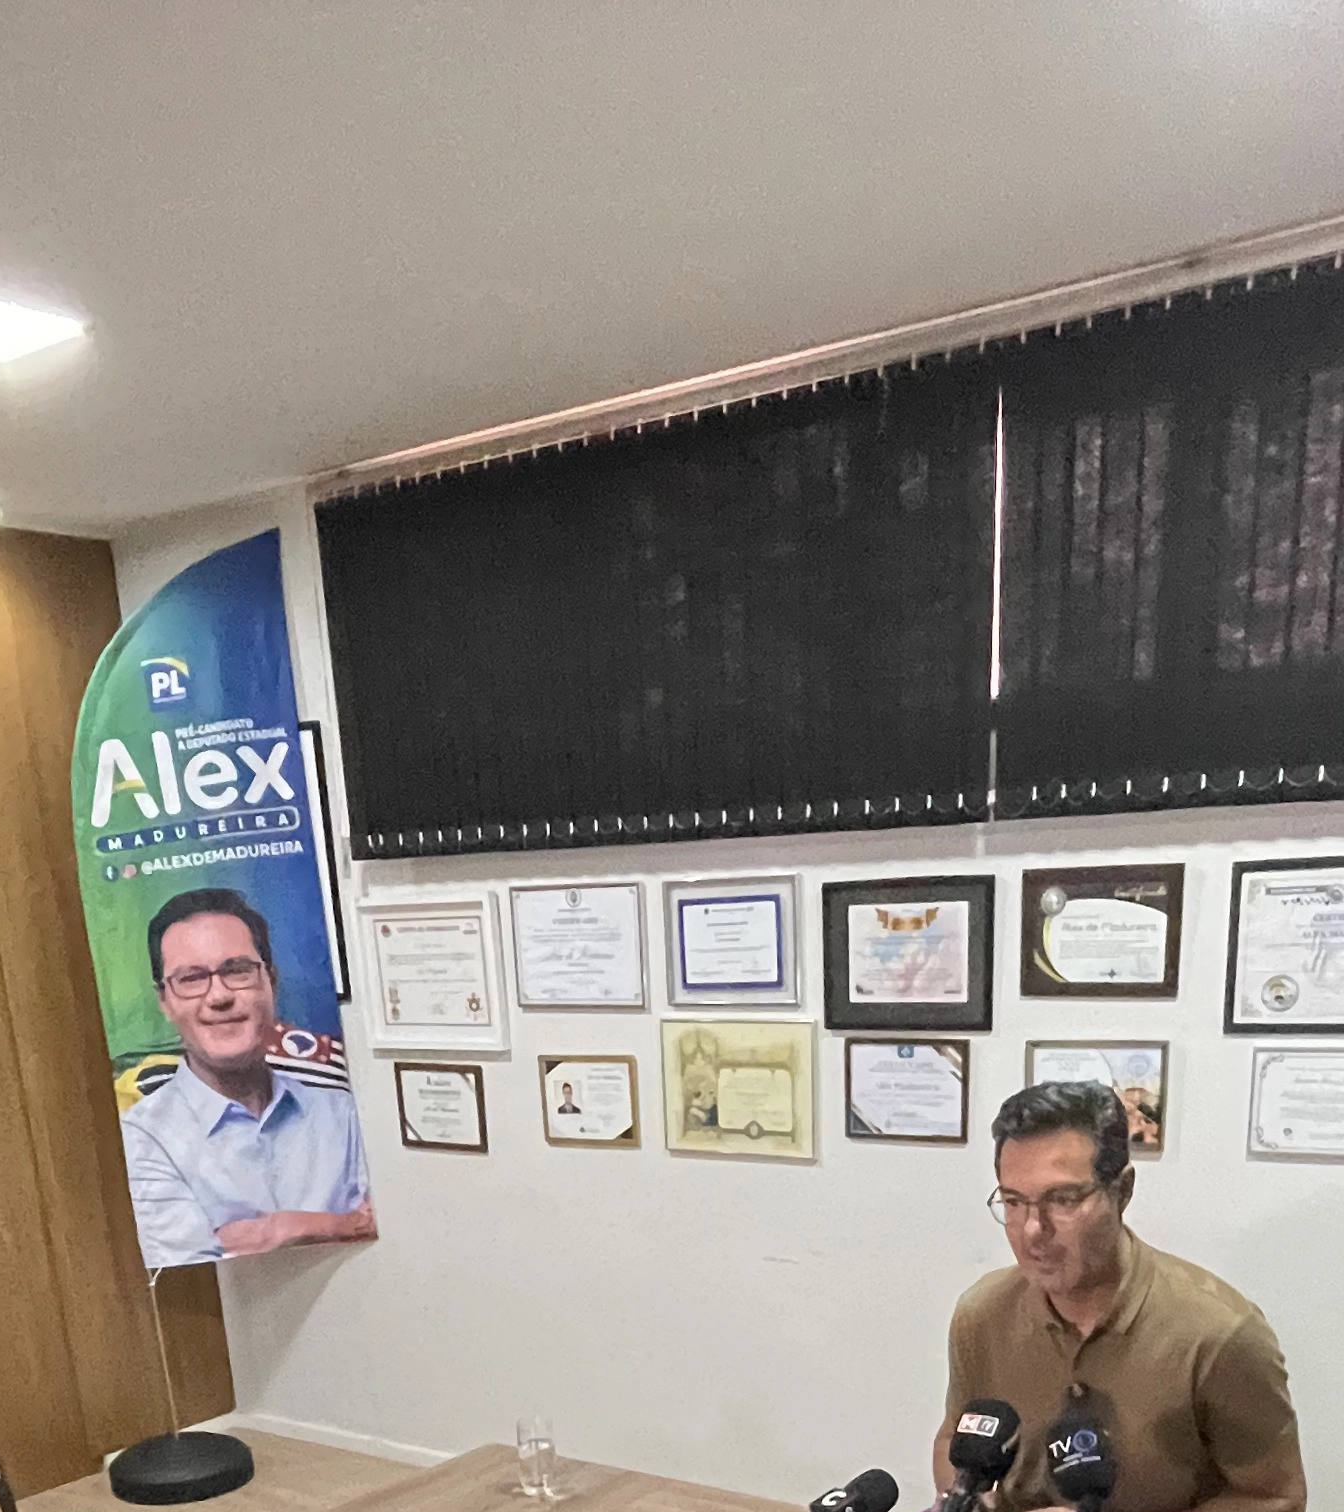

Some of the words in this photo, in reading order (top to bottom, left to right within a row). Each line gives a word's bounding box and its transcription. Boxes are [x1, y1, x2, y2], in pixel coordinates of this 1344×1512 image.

[150, 669, 187, 698] PL
[175, 717, 254, 739] PRÉ-CANDIDATO
[90, 731, 295, 828] Alex
[108, 812, 290, 850] MADUREIRA
[141, 840, 304, 875] @ALEXDEMADUREIRA
